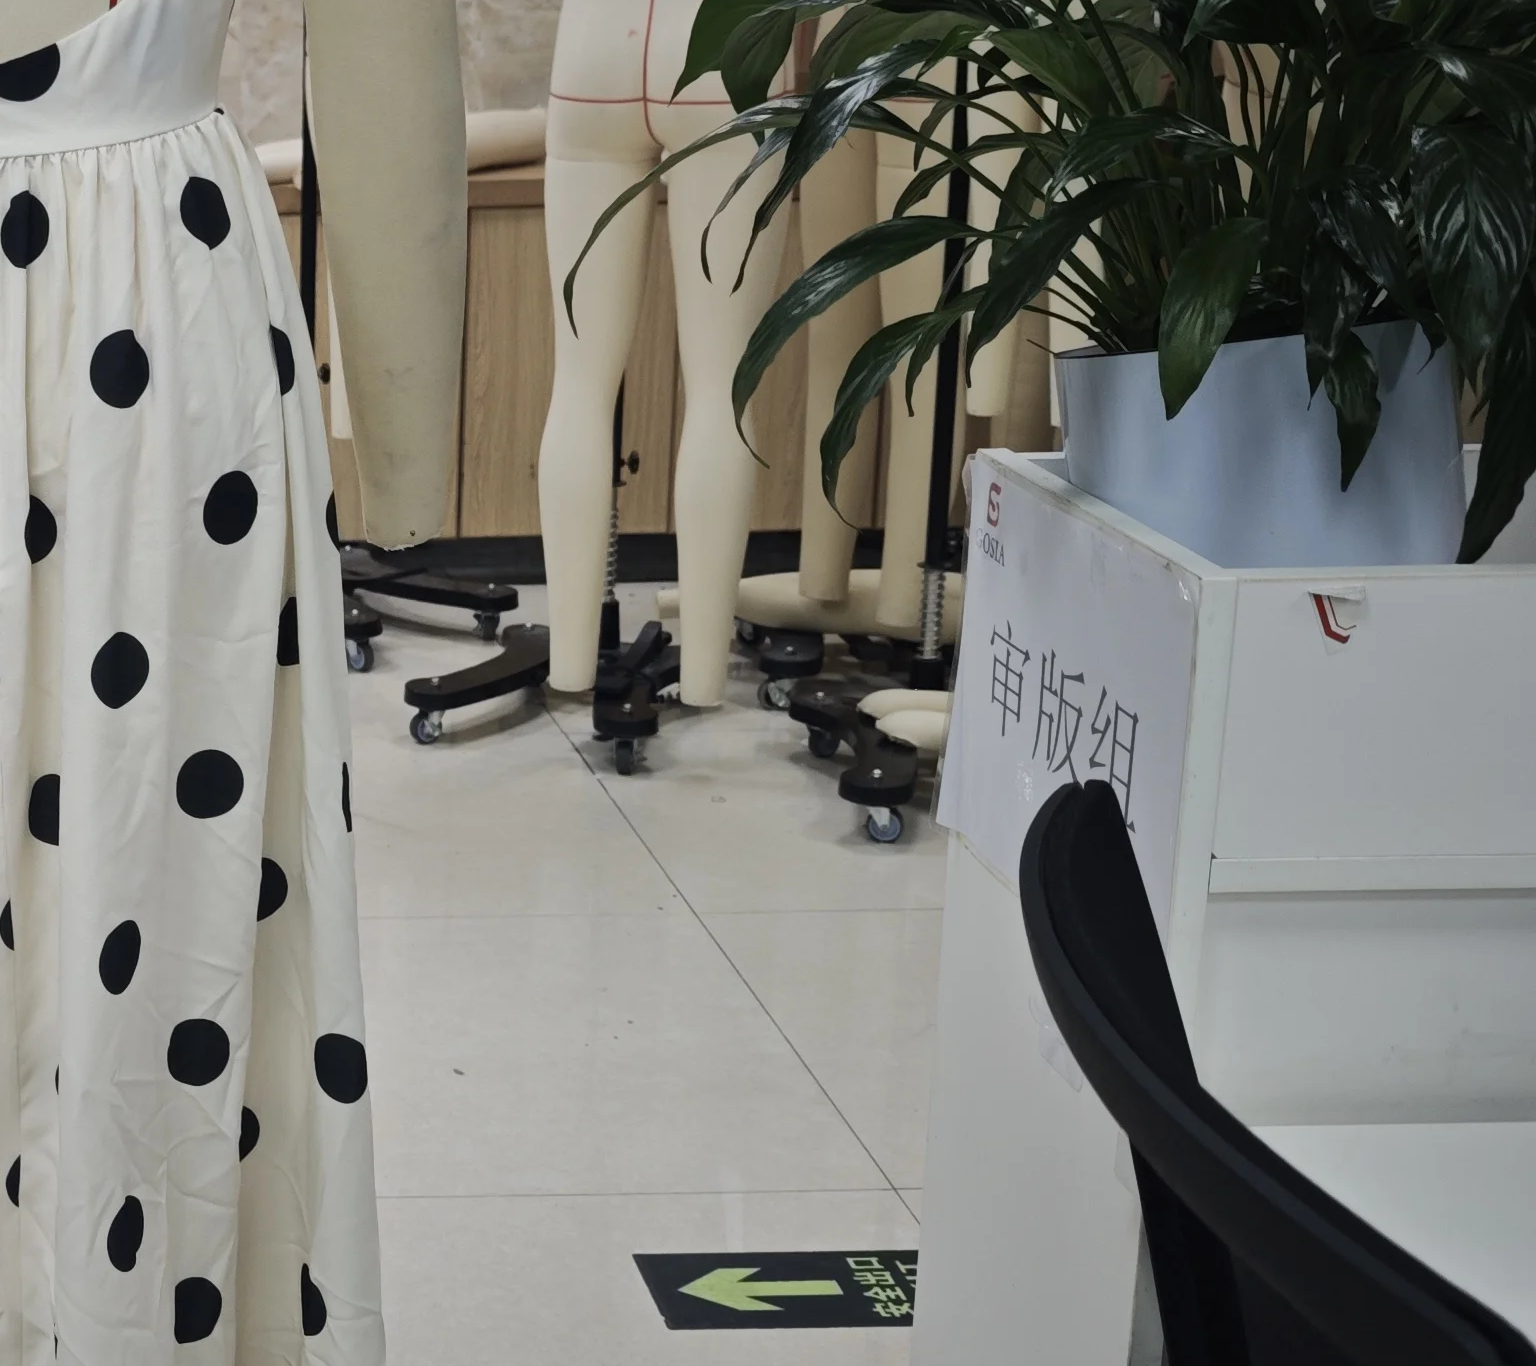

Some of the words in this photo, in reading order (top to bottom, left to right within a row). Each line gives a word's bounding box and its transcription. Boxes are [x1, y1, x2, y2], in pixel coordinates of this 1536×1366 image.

[990, 620, 1140, 833] 审版组
[846, 1256, 916, 1318] 安全出口
